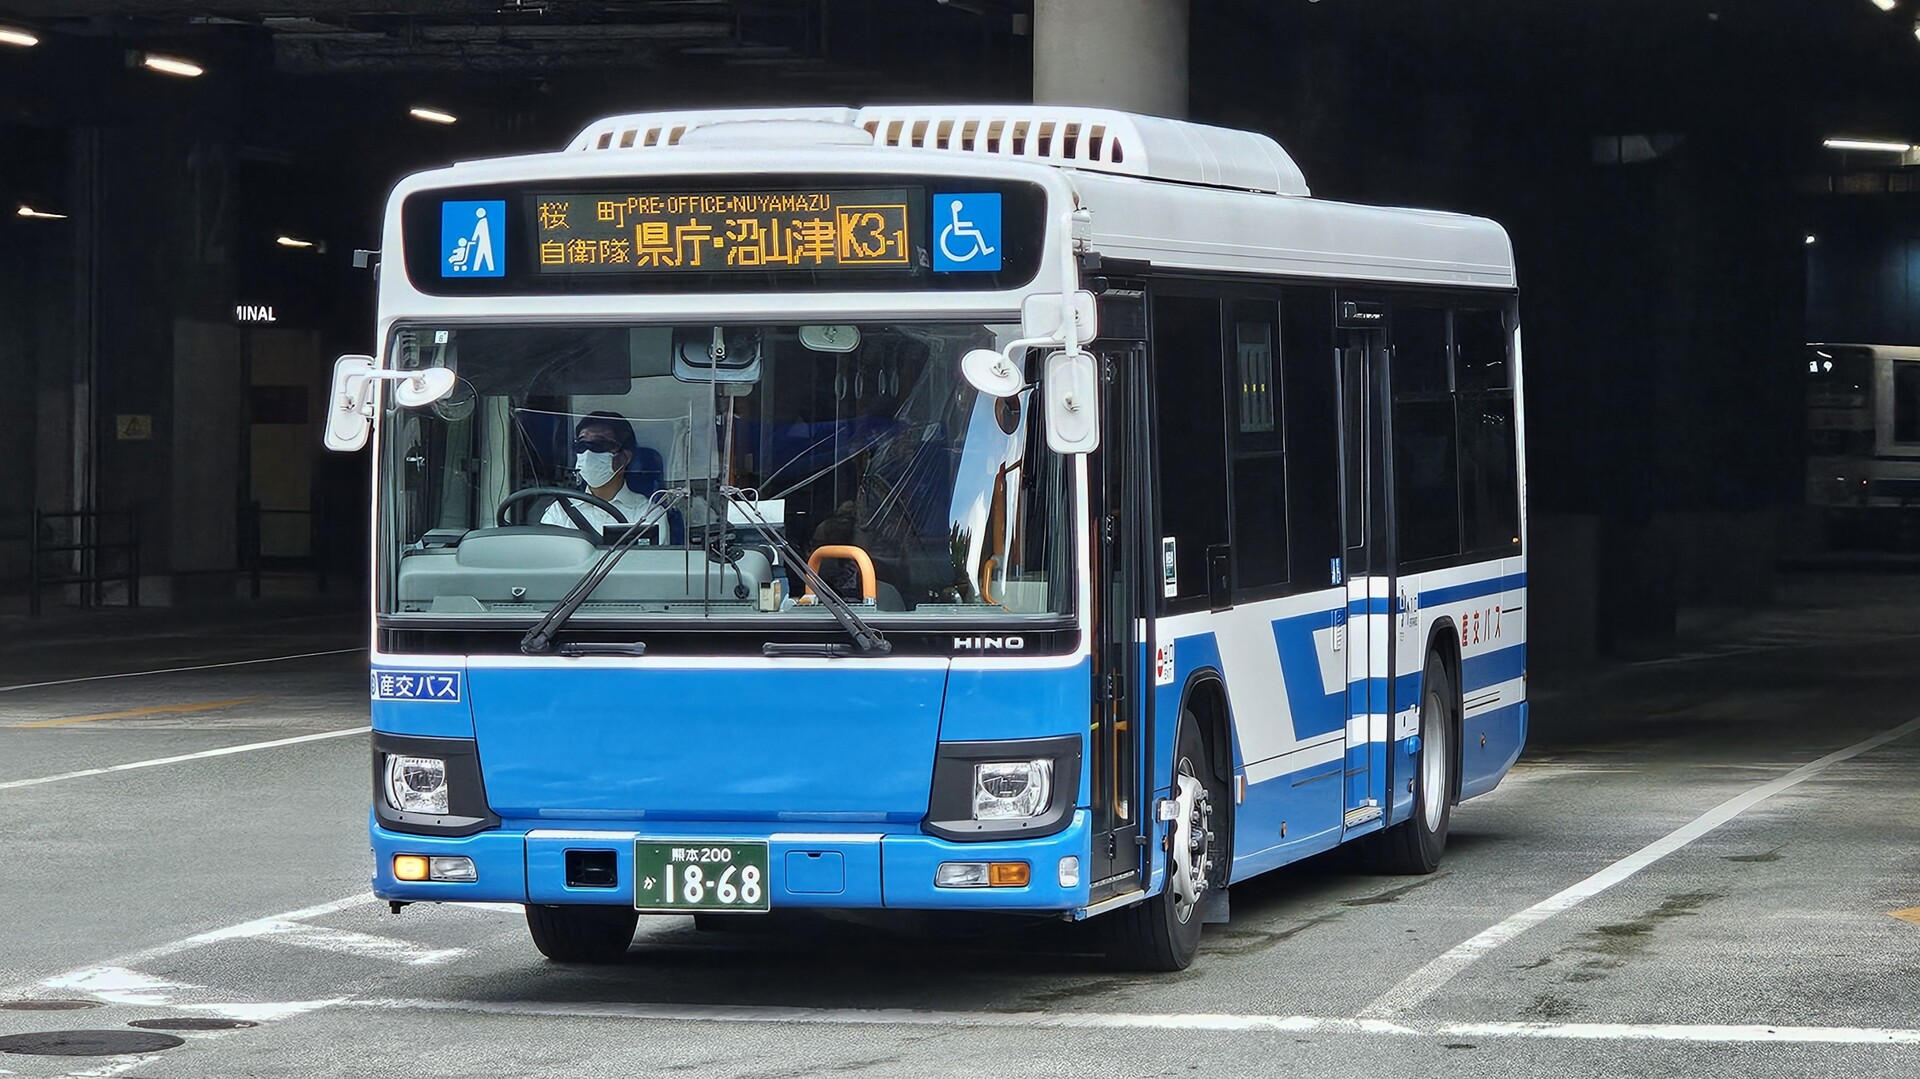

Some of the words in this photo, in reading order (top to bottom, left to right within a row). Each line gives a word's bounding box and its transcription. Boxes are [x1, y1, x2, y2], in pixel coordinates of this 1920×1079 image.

[540, 238, 630, 264] 自衛隊
[841, 212, 904, 258] K3-1
[954, 636, 1024, 649] HINO
[1462, 605, 1500, 647] 産交バス
[380, 673, 456, 697] 産交バス
[643, 875, 657, 890] か
[665, 864, 762, 904] 18-68
